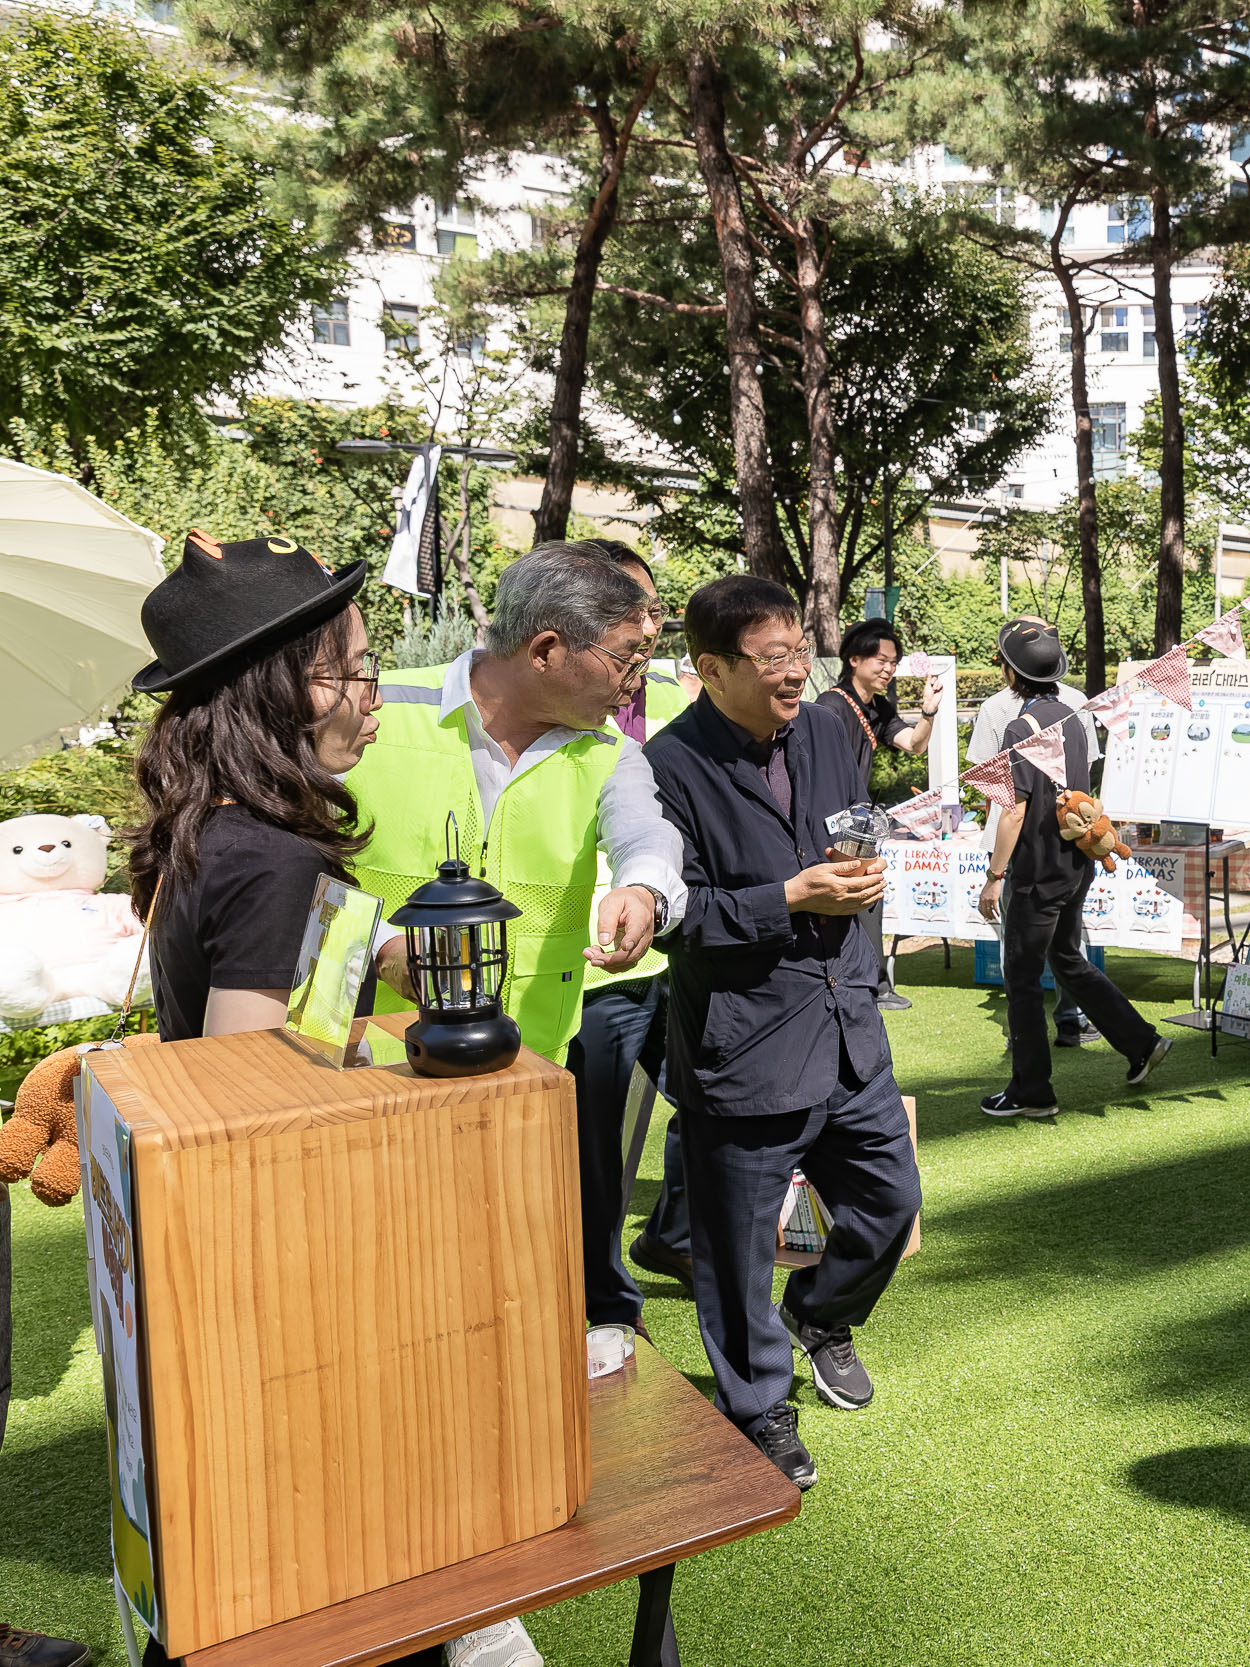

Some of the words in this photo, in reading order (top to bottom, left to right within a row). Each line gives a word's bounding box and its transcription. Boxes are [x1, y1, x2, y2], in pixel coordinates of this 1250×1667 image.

[905, 849, 951, 861] LIBRARY
[904, 860, 950, 873] DAMAS
[1126, 856, 1178, 869] LIBRARY
[1126, 868, 1176, 882] DAMAS
